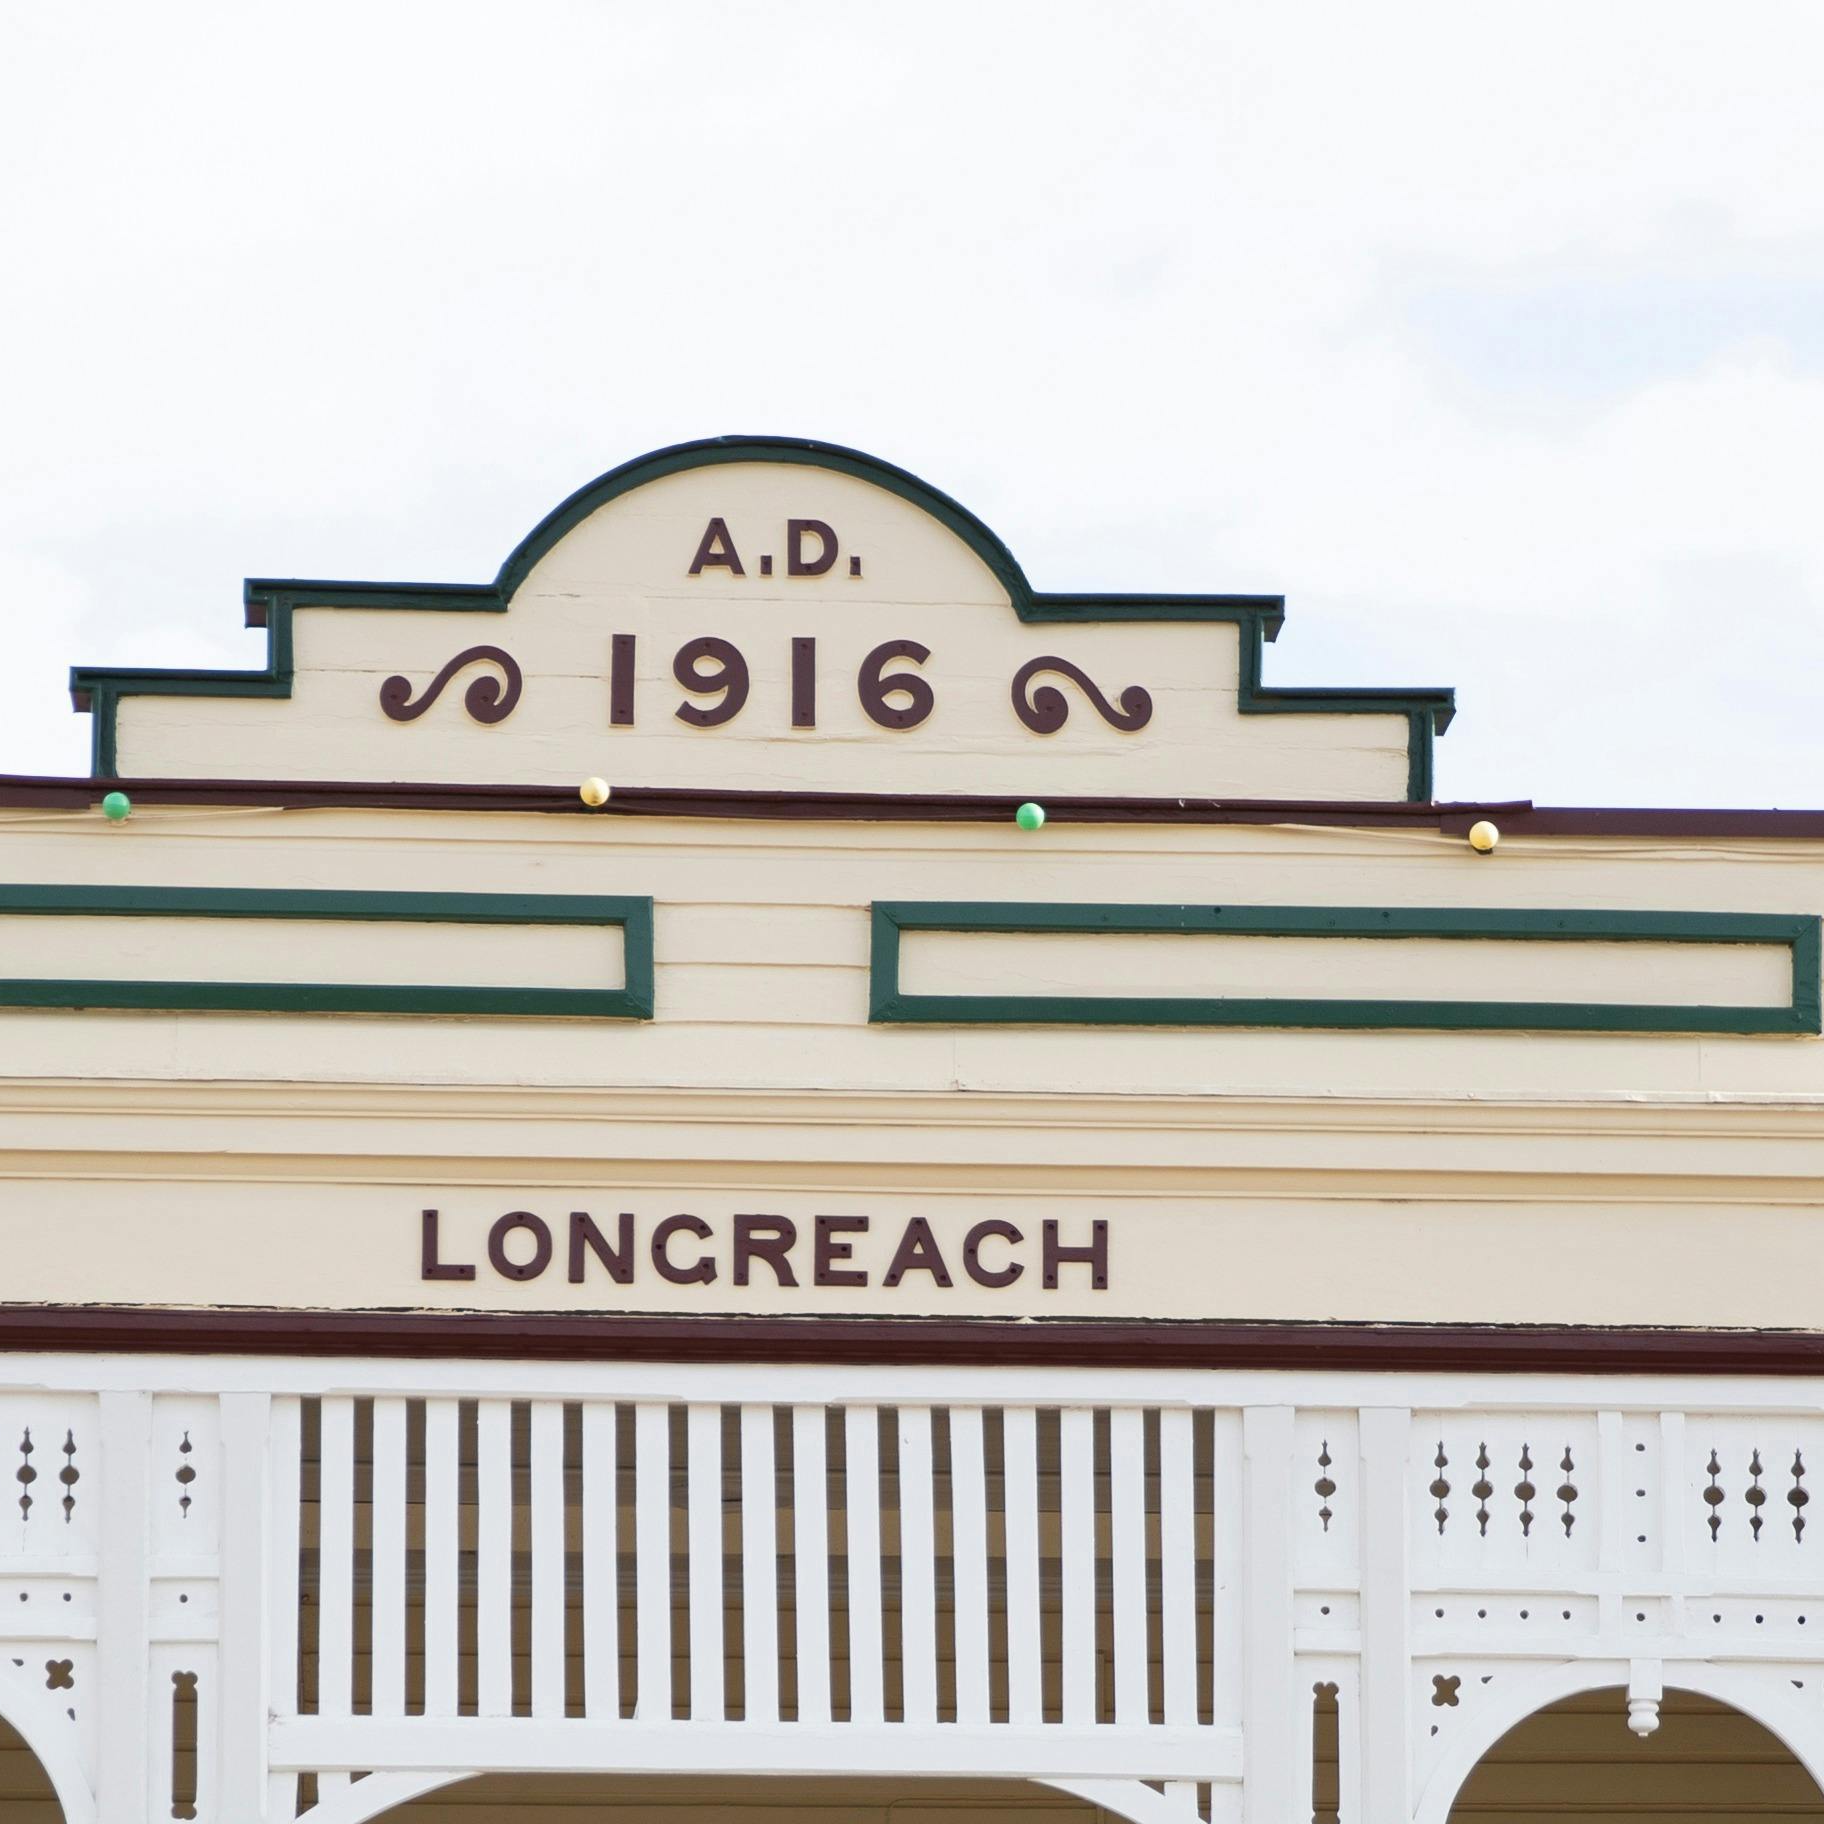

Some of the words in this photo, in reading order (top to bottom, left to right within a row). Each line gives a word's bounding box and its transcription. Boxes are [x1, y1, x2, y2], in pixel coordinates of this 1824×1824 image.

[687, 516, 864, 578] A.D.
[610, 633, 935, 731] 1916
[420, 1207, 1110, 1292] LONGREACH
